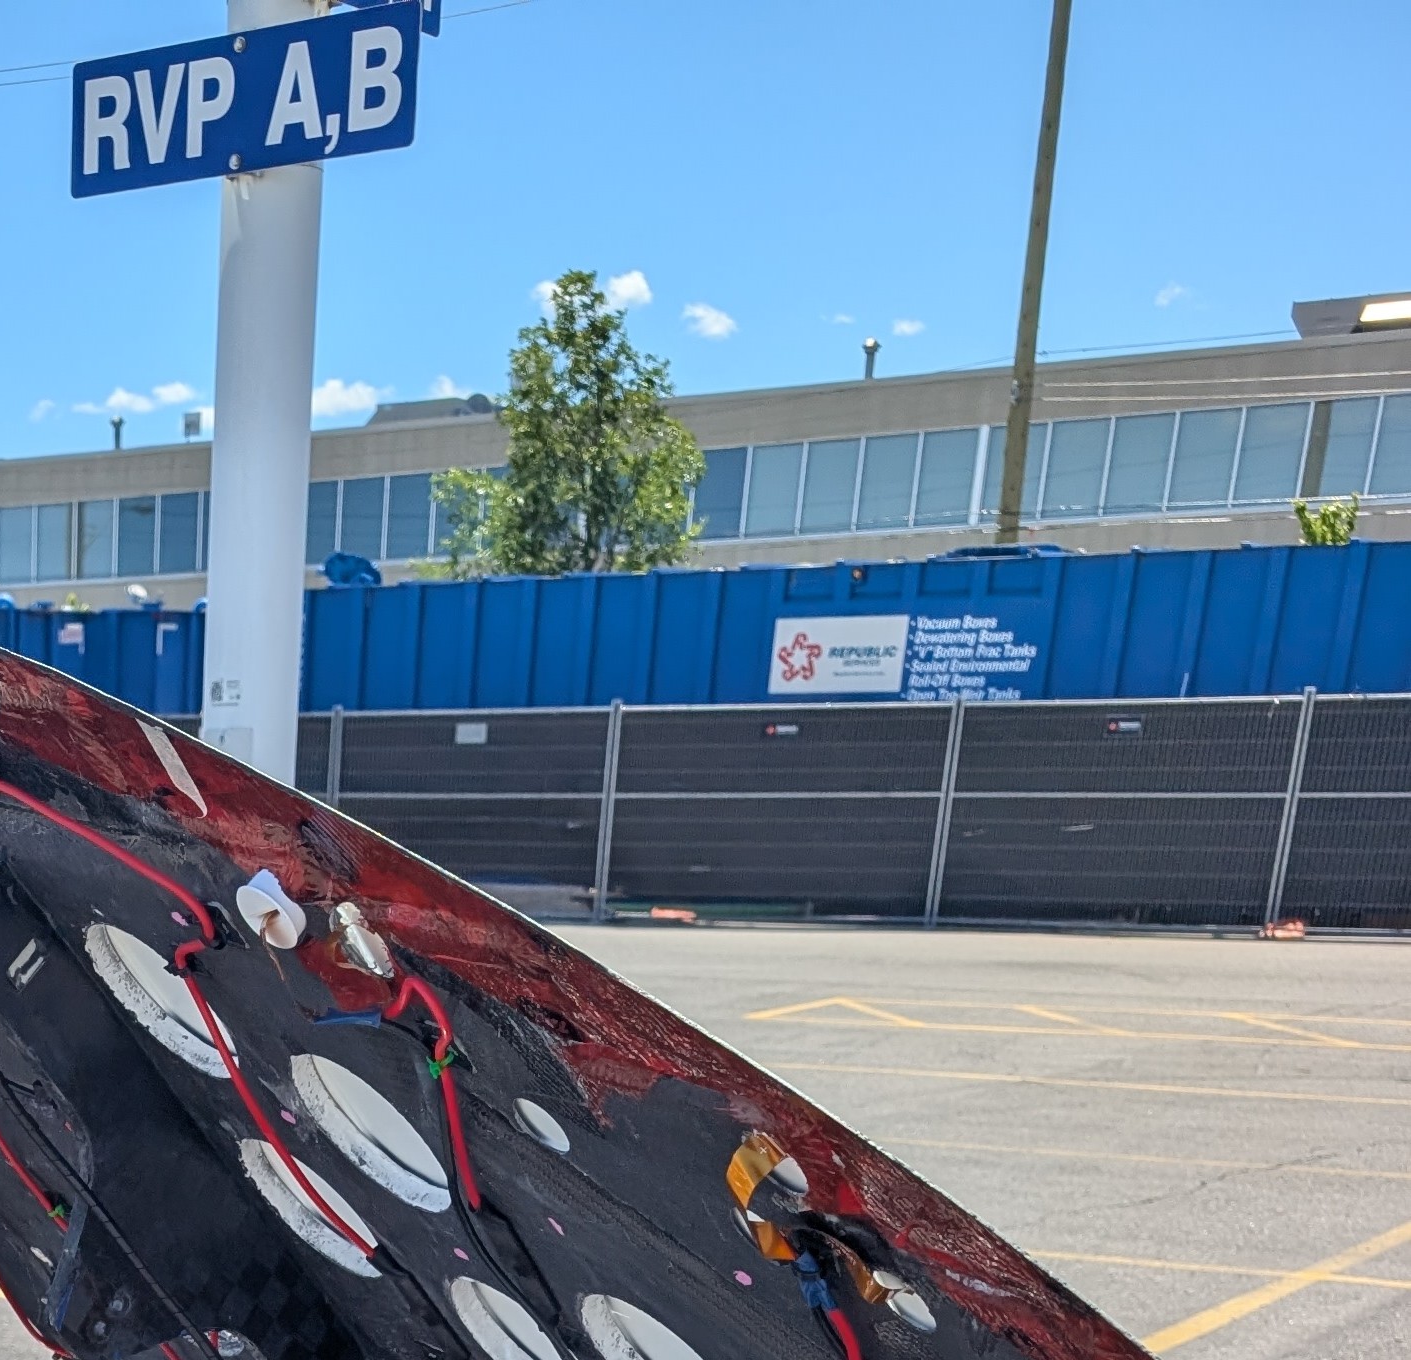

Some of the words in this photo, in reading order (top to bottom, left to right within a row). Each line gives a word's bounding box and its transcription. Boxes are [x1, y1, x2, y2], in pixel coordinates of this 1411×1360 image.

[83, 56, 235, 175] RVP
[265, 26, 403, 154] A,B
[917, 616, 961, 629] Vacuum
[962, 615, 998, 629] Boxes
[828, 645, 898, 658] REPUBLIC
